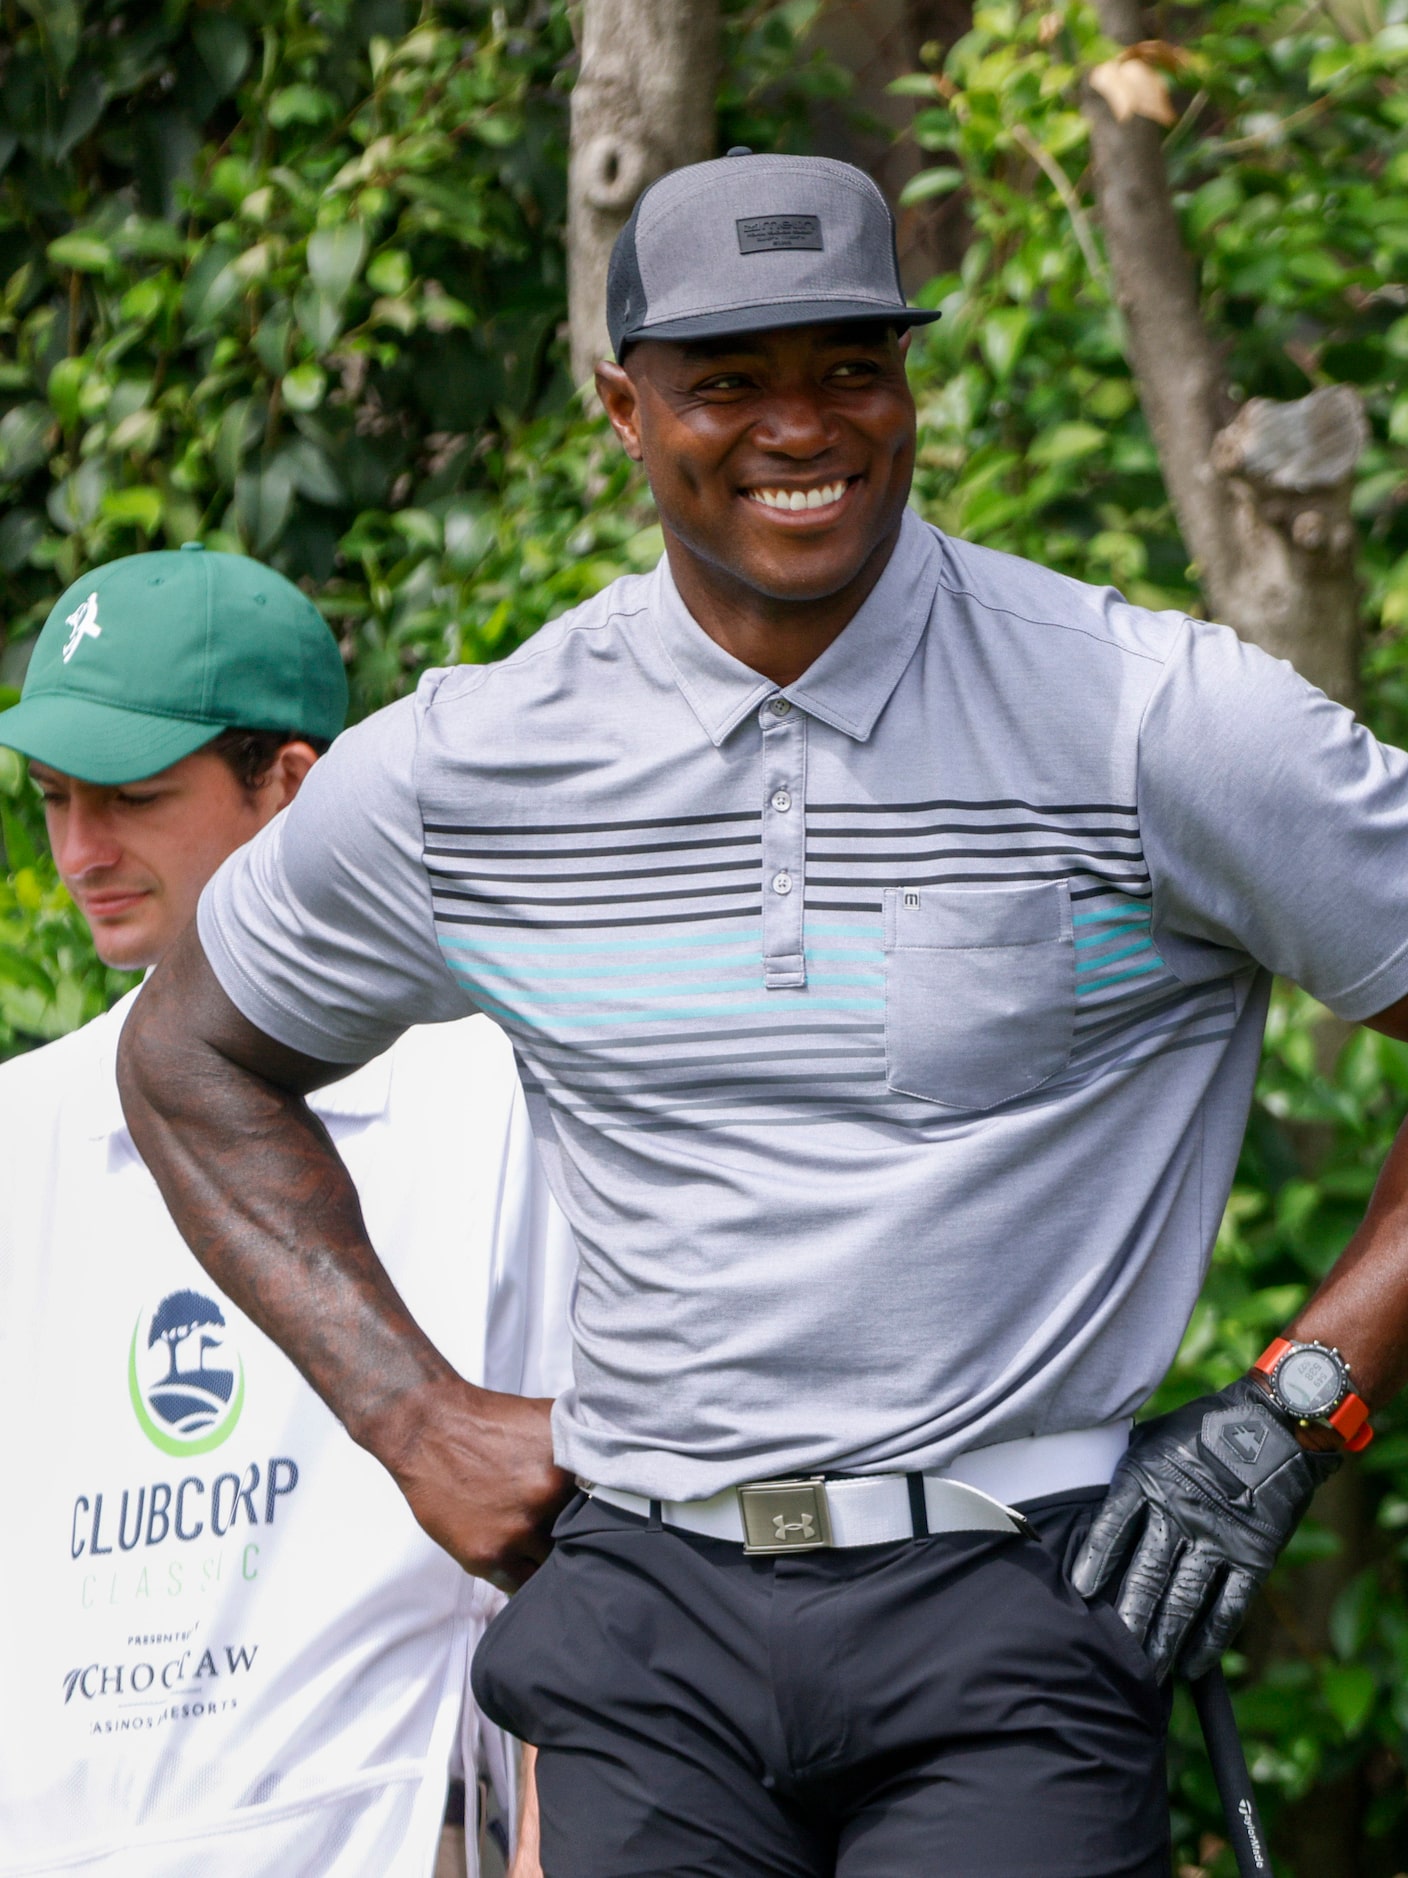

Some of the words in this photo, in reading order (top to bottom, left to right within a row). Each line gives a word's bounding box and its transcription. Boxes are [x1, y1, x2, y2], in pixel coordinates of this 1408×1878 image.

[71, 1456, 299, 1560] CLUBCORP
[81, 1543, 260, 1610] CLASSIC
[91, 1716, 153, 1735] ASINOS
[1238, 1798, 1265, 1869] TaylorMade
